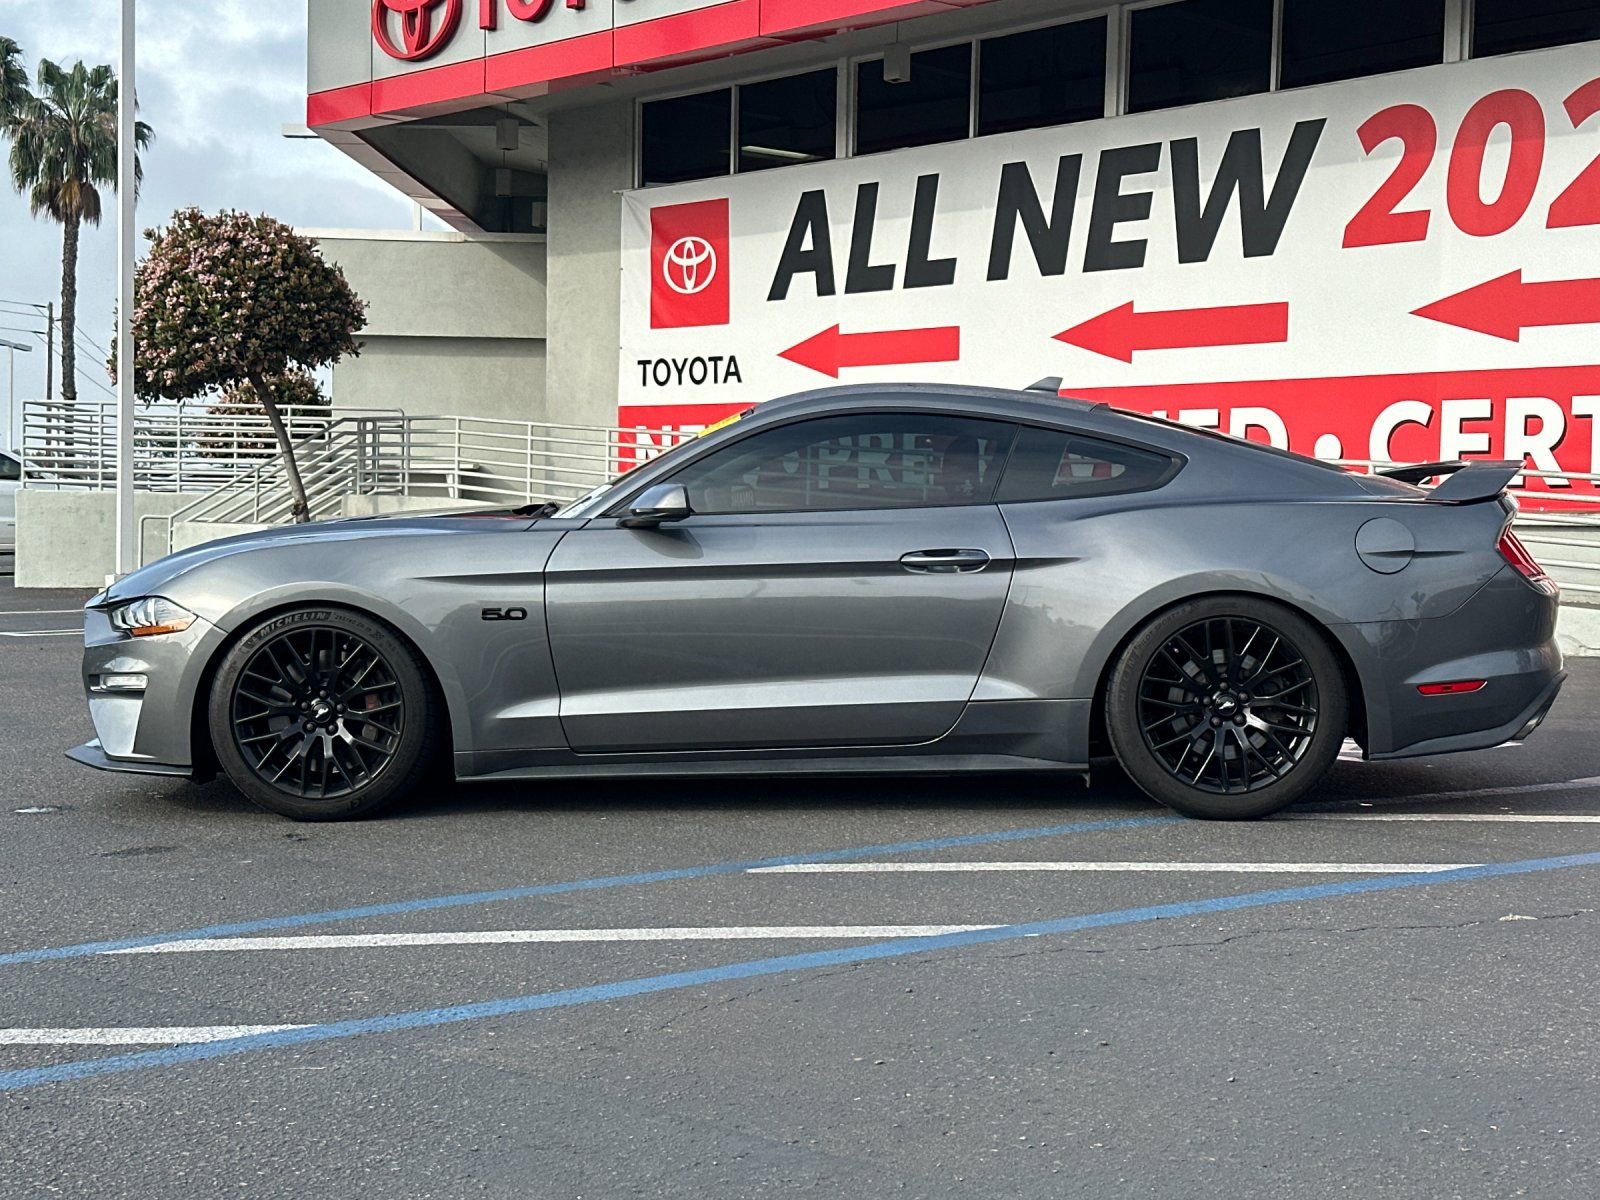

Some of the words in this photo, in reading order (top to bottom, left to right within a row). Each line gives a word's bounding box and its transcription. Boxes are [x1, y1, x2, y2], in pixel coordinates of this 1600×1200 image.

[767, 173, 957, 300] ALL
[986, 118, 1328, 281] NEW
[637, 355, 742, 387] TOYOTA
[260, 611, 327, 637] MICHELIN
